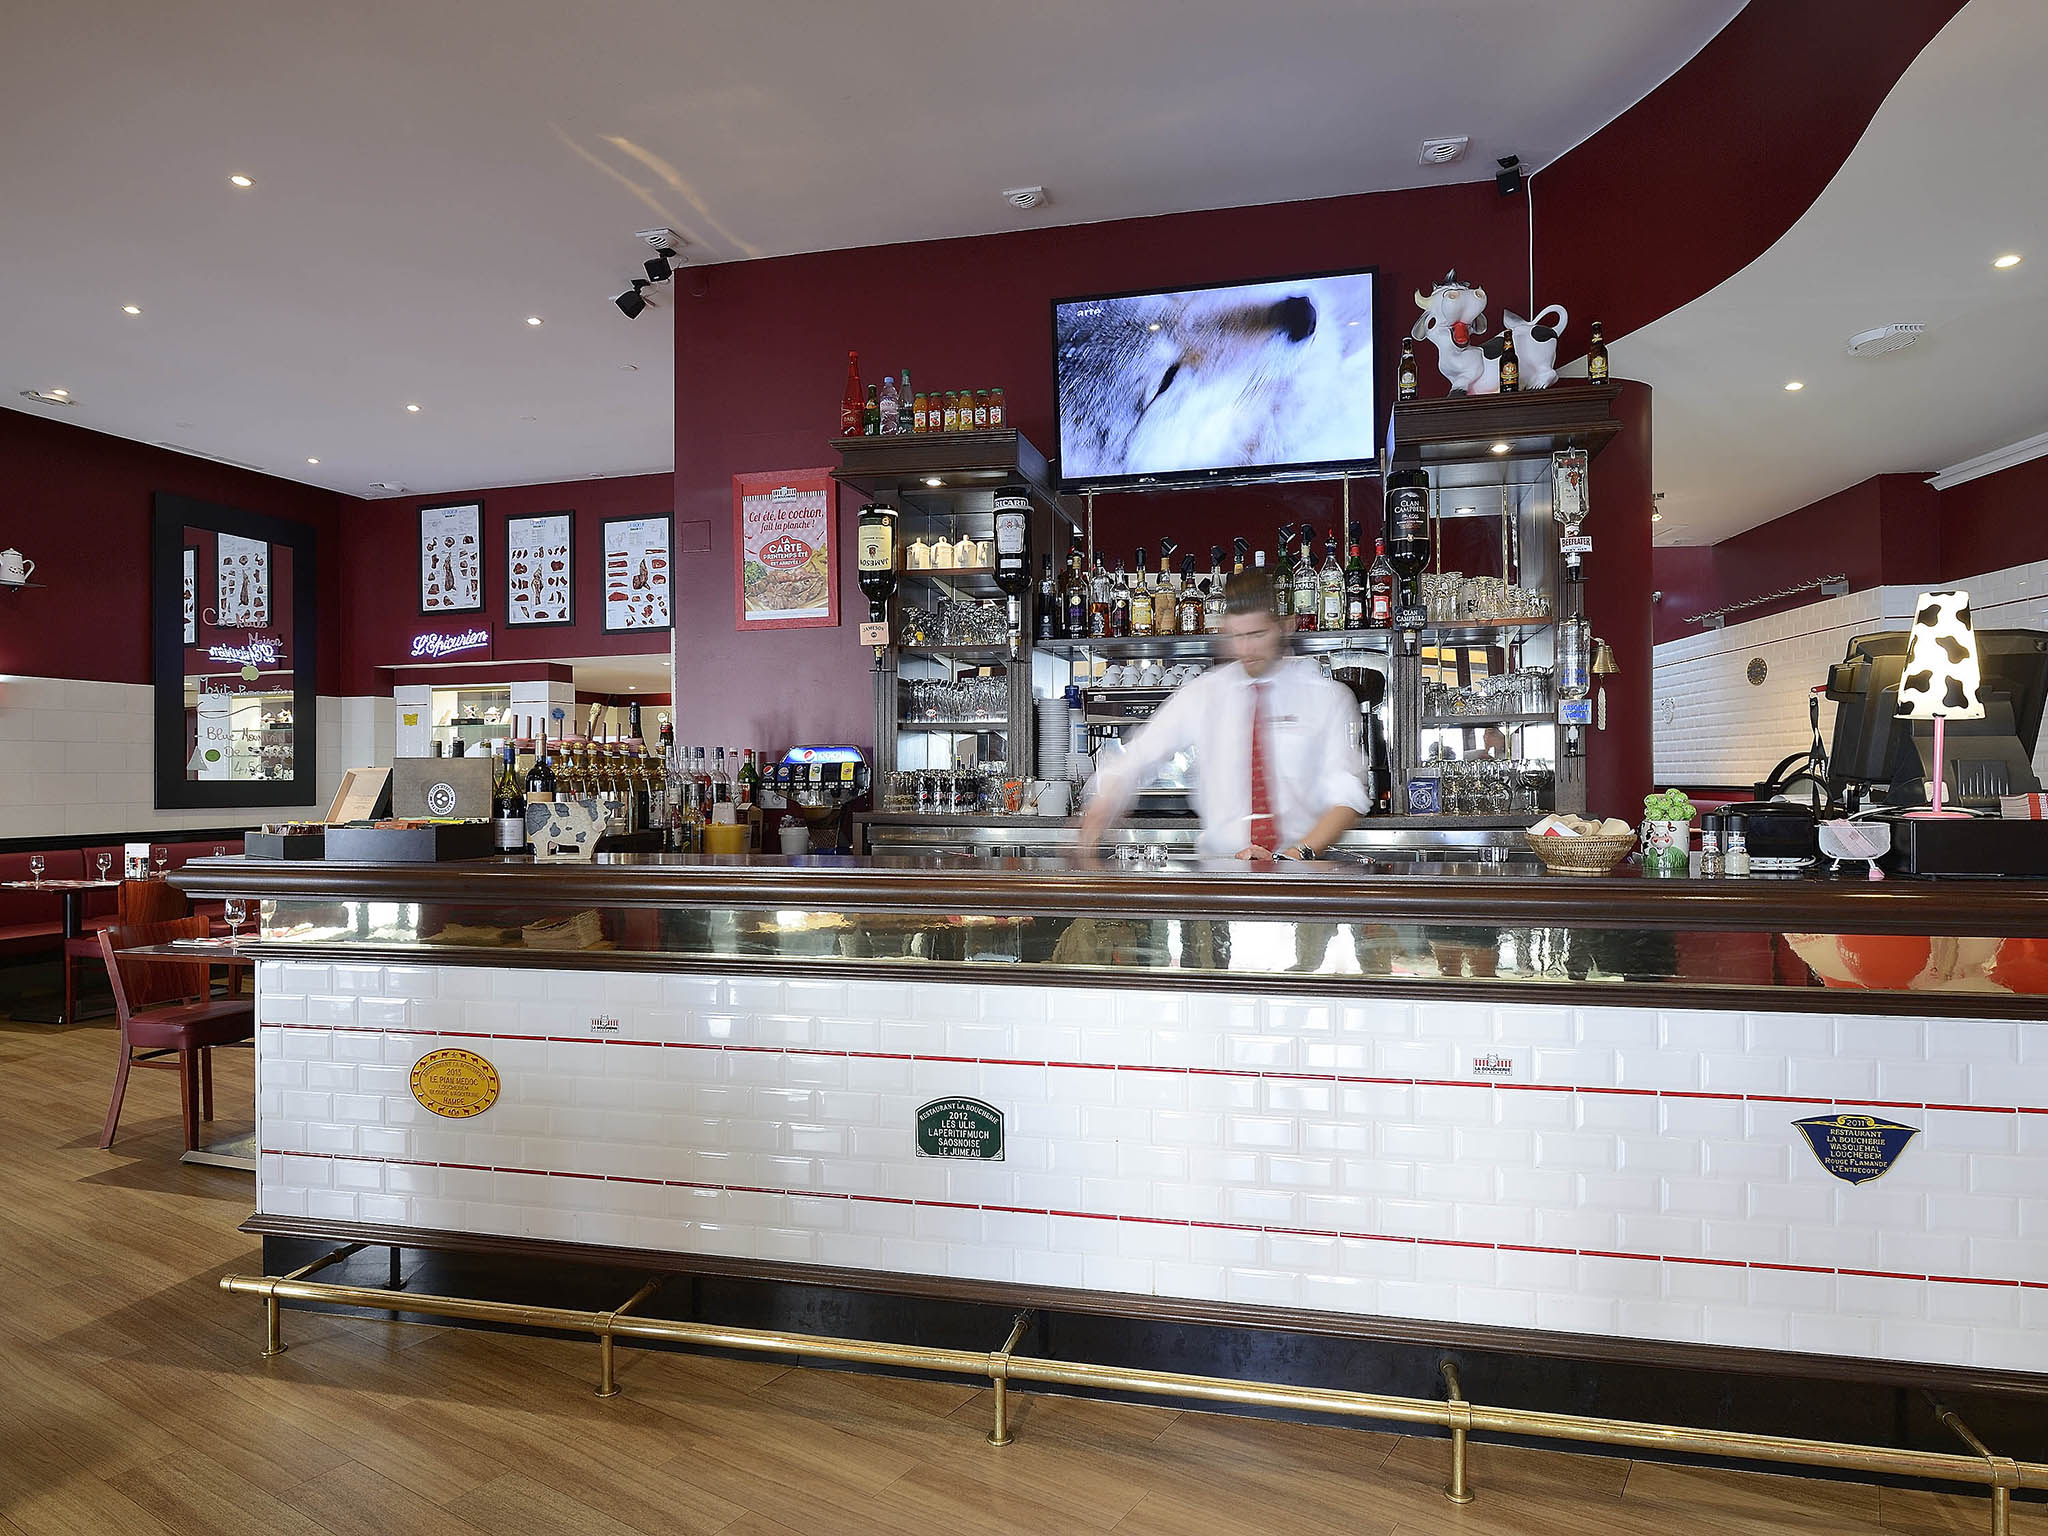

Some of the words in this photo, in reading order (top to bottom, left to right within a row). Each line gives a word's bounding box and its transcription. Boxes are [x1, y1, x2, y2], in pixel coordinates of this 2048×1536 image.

[1077, 307, 1102, 317] arte
[995, 499, 1027, 508] RICARD
[749, 511, 761, 522] Cet
[777, 509, 786, 520] le
[788, 507, 824, 519] cochon,
[1394, 506, 1425, 514] CAMPBELL
[760, 522, 773, 534] fait
[775, 522, 783, 530] la
[783, 521, 810, 532] planche
[1561, 537, 1591, 547] BEEFEATER
[769, 544, 802, 553] CARTE
[763, 552, 797, 560] PRINTEMPS
[207, 727, 238, 741] Blue
[430, 1075, 437, 1083] LE
[443, 1097, 465, 1106] HAMPE
[919, 1103, 956, 1121] RESTAURANT
[965, 1104, 1000, 1125] BOUCHERIE
[949, 1112, 968, 1120] 2012
[941, 1120, 956, 1128] LES
[958, 1120, 976, 1129] ULIS
[1847, 1119, 1865, 1127] 2011
[1830, 1129, 1882, 1137] RESTAURANT
[938, 1137, 981, 1148] SAOSNOISE
[1839, 1136, 1886, 1146] BOUCHERIE
[938, 1147, 948, 1155] LE
[950, 1148, 981, 1157] JUMEAU
[1830, 1151, 1882, 1160] LOUCHEBEM
[1825, 1157, 1849, 1166] ROUGE
[1849, 1159, 1888, 1168] FLAMANDE
